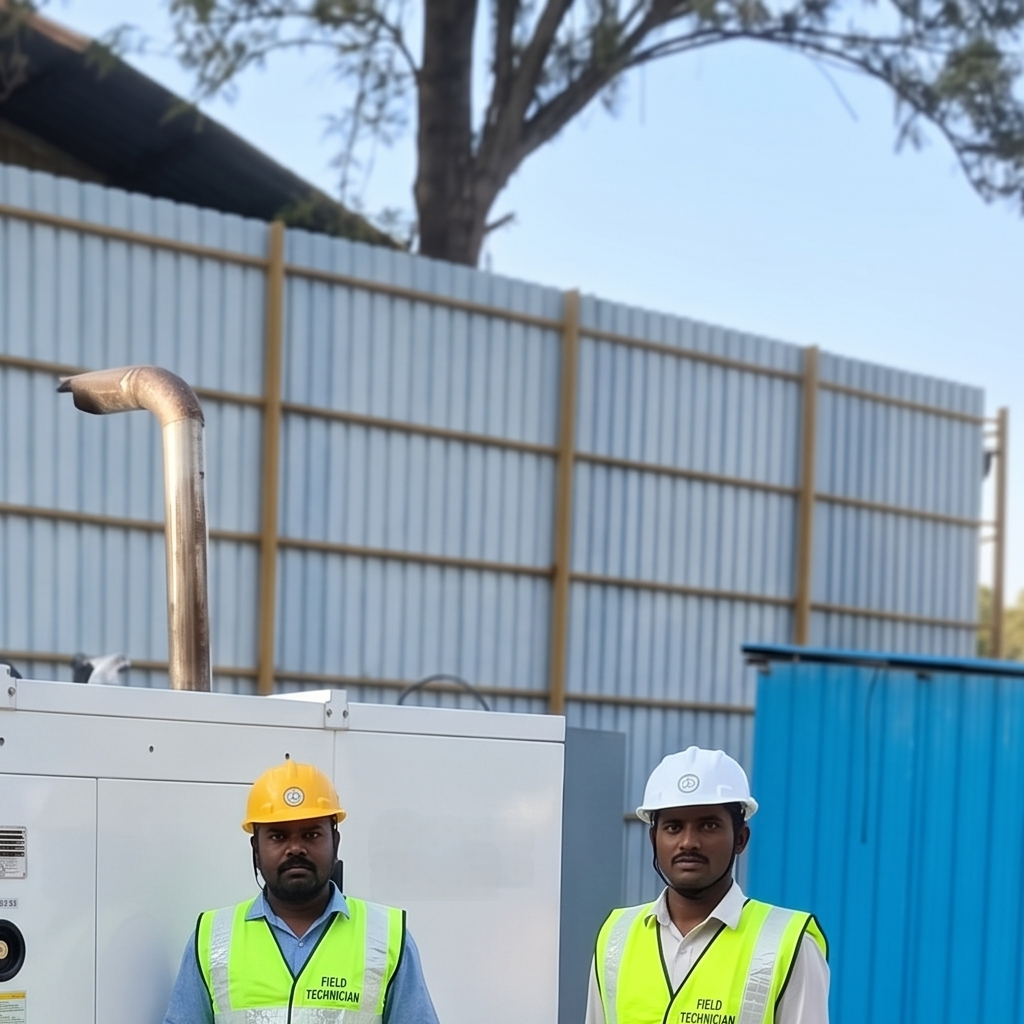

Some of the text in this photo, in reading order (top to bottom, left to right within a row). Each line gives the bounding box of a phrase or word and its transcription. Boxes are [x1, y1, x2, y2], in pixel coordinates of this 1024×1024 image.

[321, 976, 347, 988] FIELD
[306, 989, 360, 1003] TECHNICIAN
[696, 998, 723, 1011] FIELD
